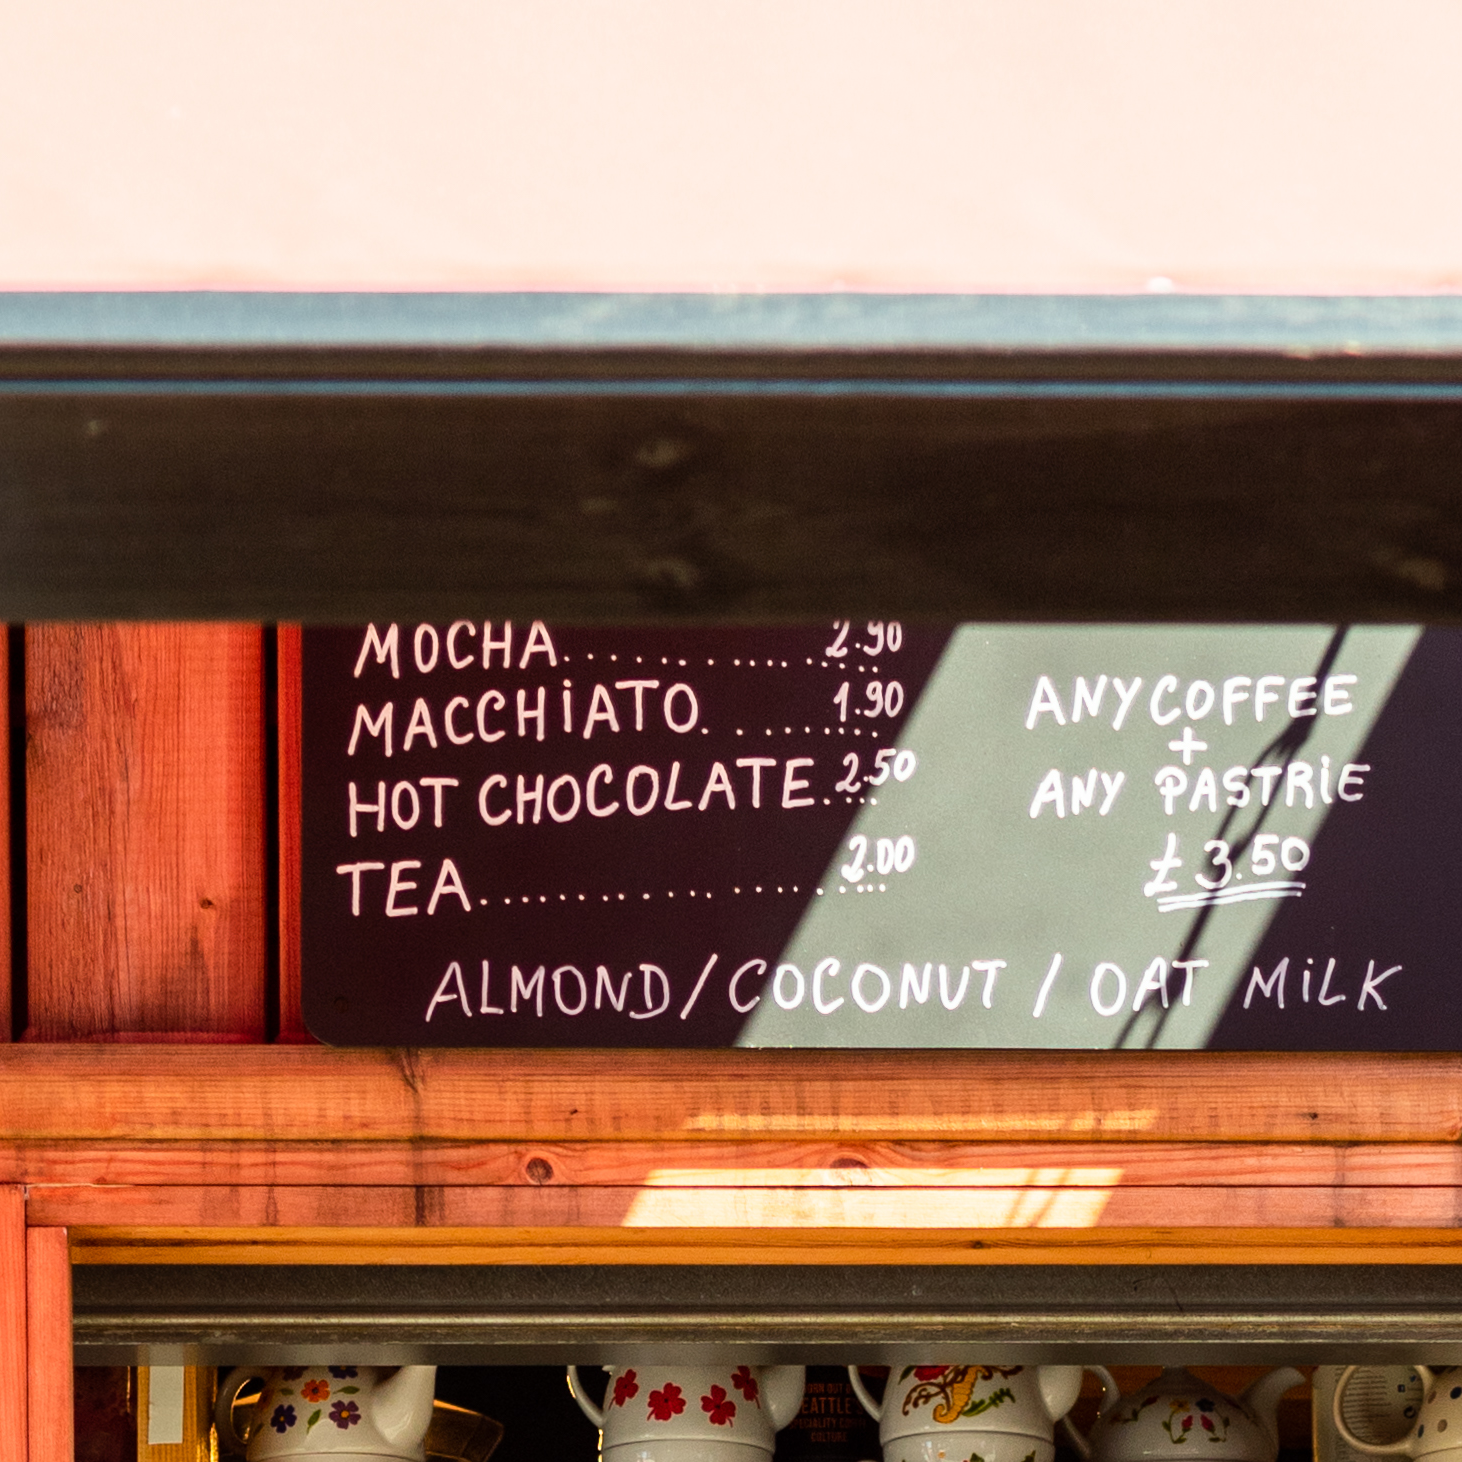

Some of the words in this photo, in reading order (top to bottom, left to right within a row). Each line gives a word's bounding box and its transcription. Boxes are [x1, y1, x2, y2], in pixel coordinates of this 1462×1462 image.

[354, 620, 557, 678] MOCHA
[833, 681, 905, 722] 1.90
[1149, 674, 1358, 726] COFFEE
[349, 777, 459, 837] HOT
[479, 758, 815, 826] CHOCOLATE
[836, 748, 918, 794] 2.50
[1029, 766, 1126, 818] ANY
[337, 859, 472, 917] TEA
[841, 834, 916, 880] 2.00
[1089, 960, 1211, 1015] OAT
